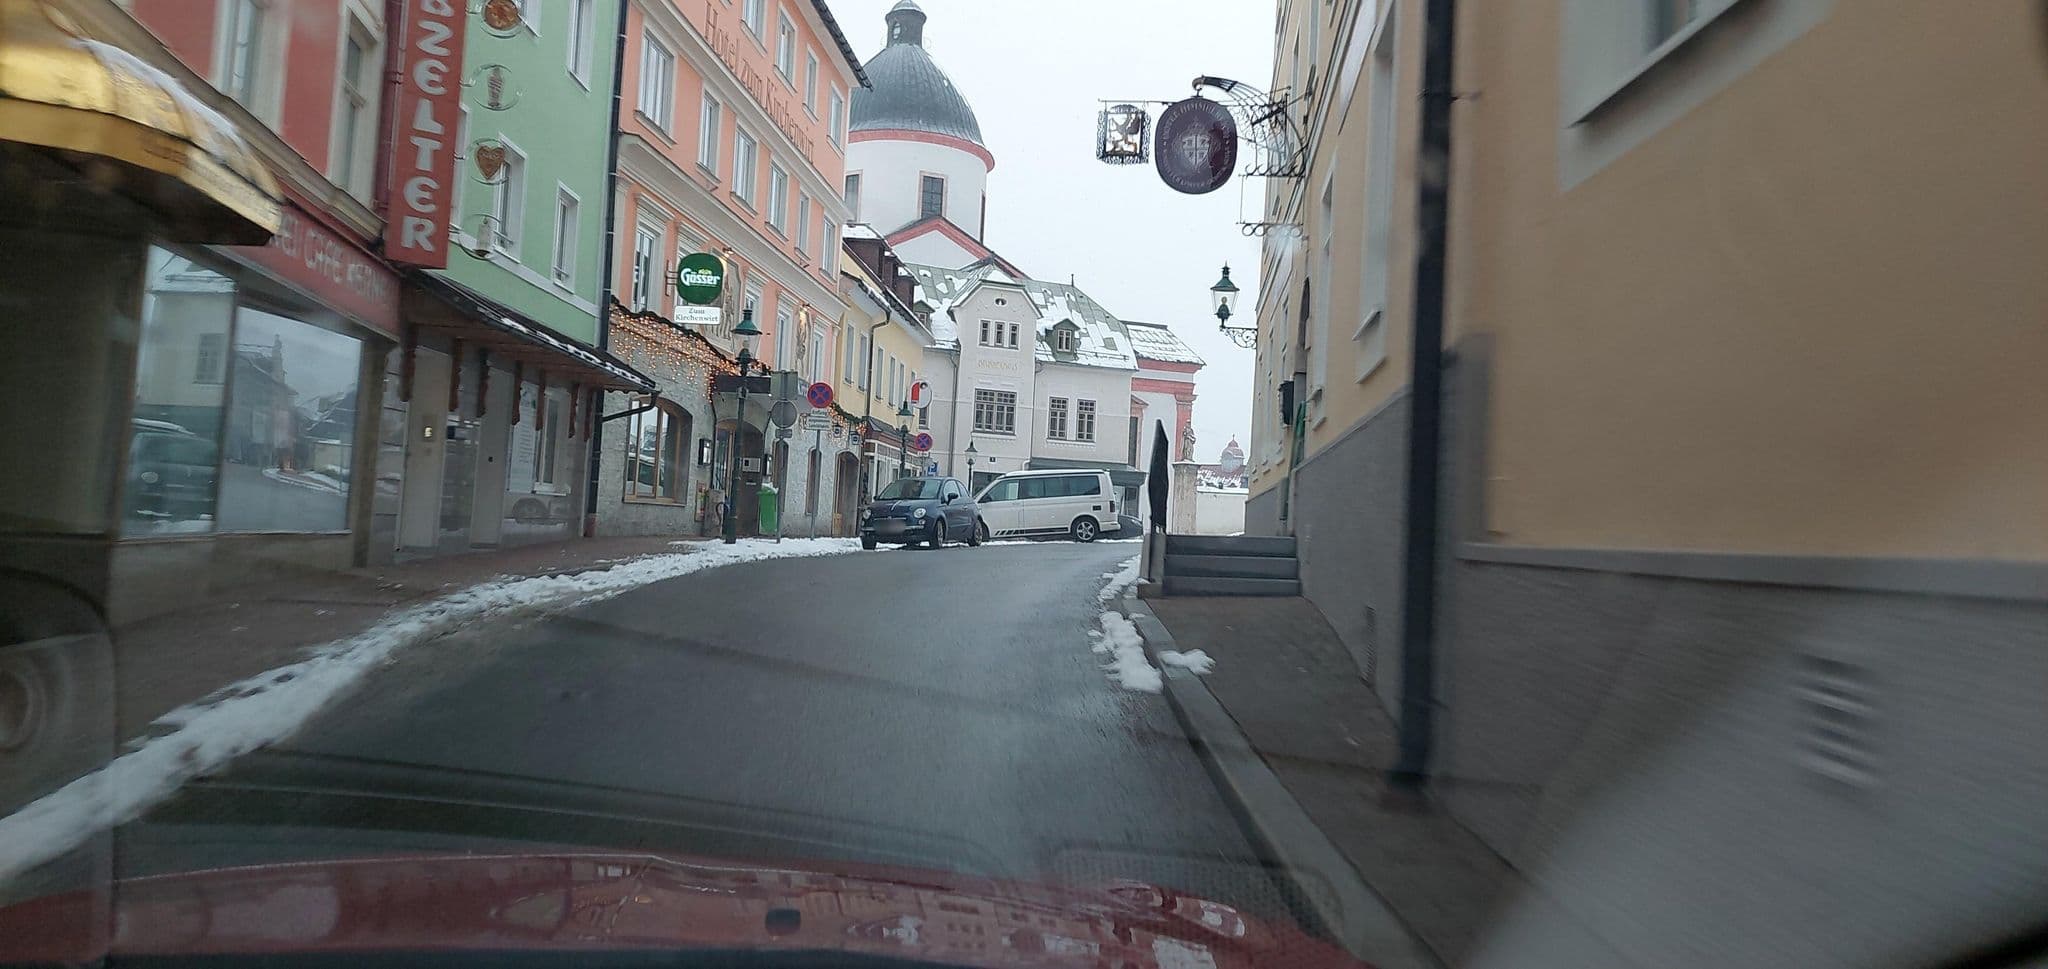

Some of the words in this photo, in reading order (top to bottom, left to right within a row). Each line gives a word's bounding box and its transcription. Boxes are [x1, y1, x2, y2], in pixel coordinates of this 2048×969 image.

[703, 2, 739, 76] Hotel
[680, 267, 720, 287] Gösser
[675, 314, 719, 322] Kirchenwirt
